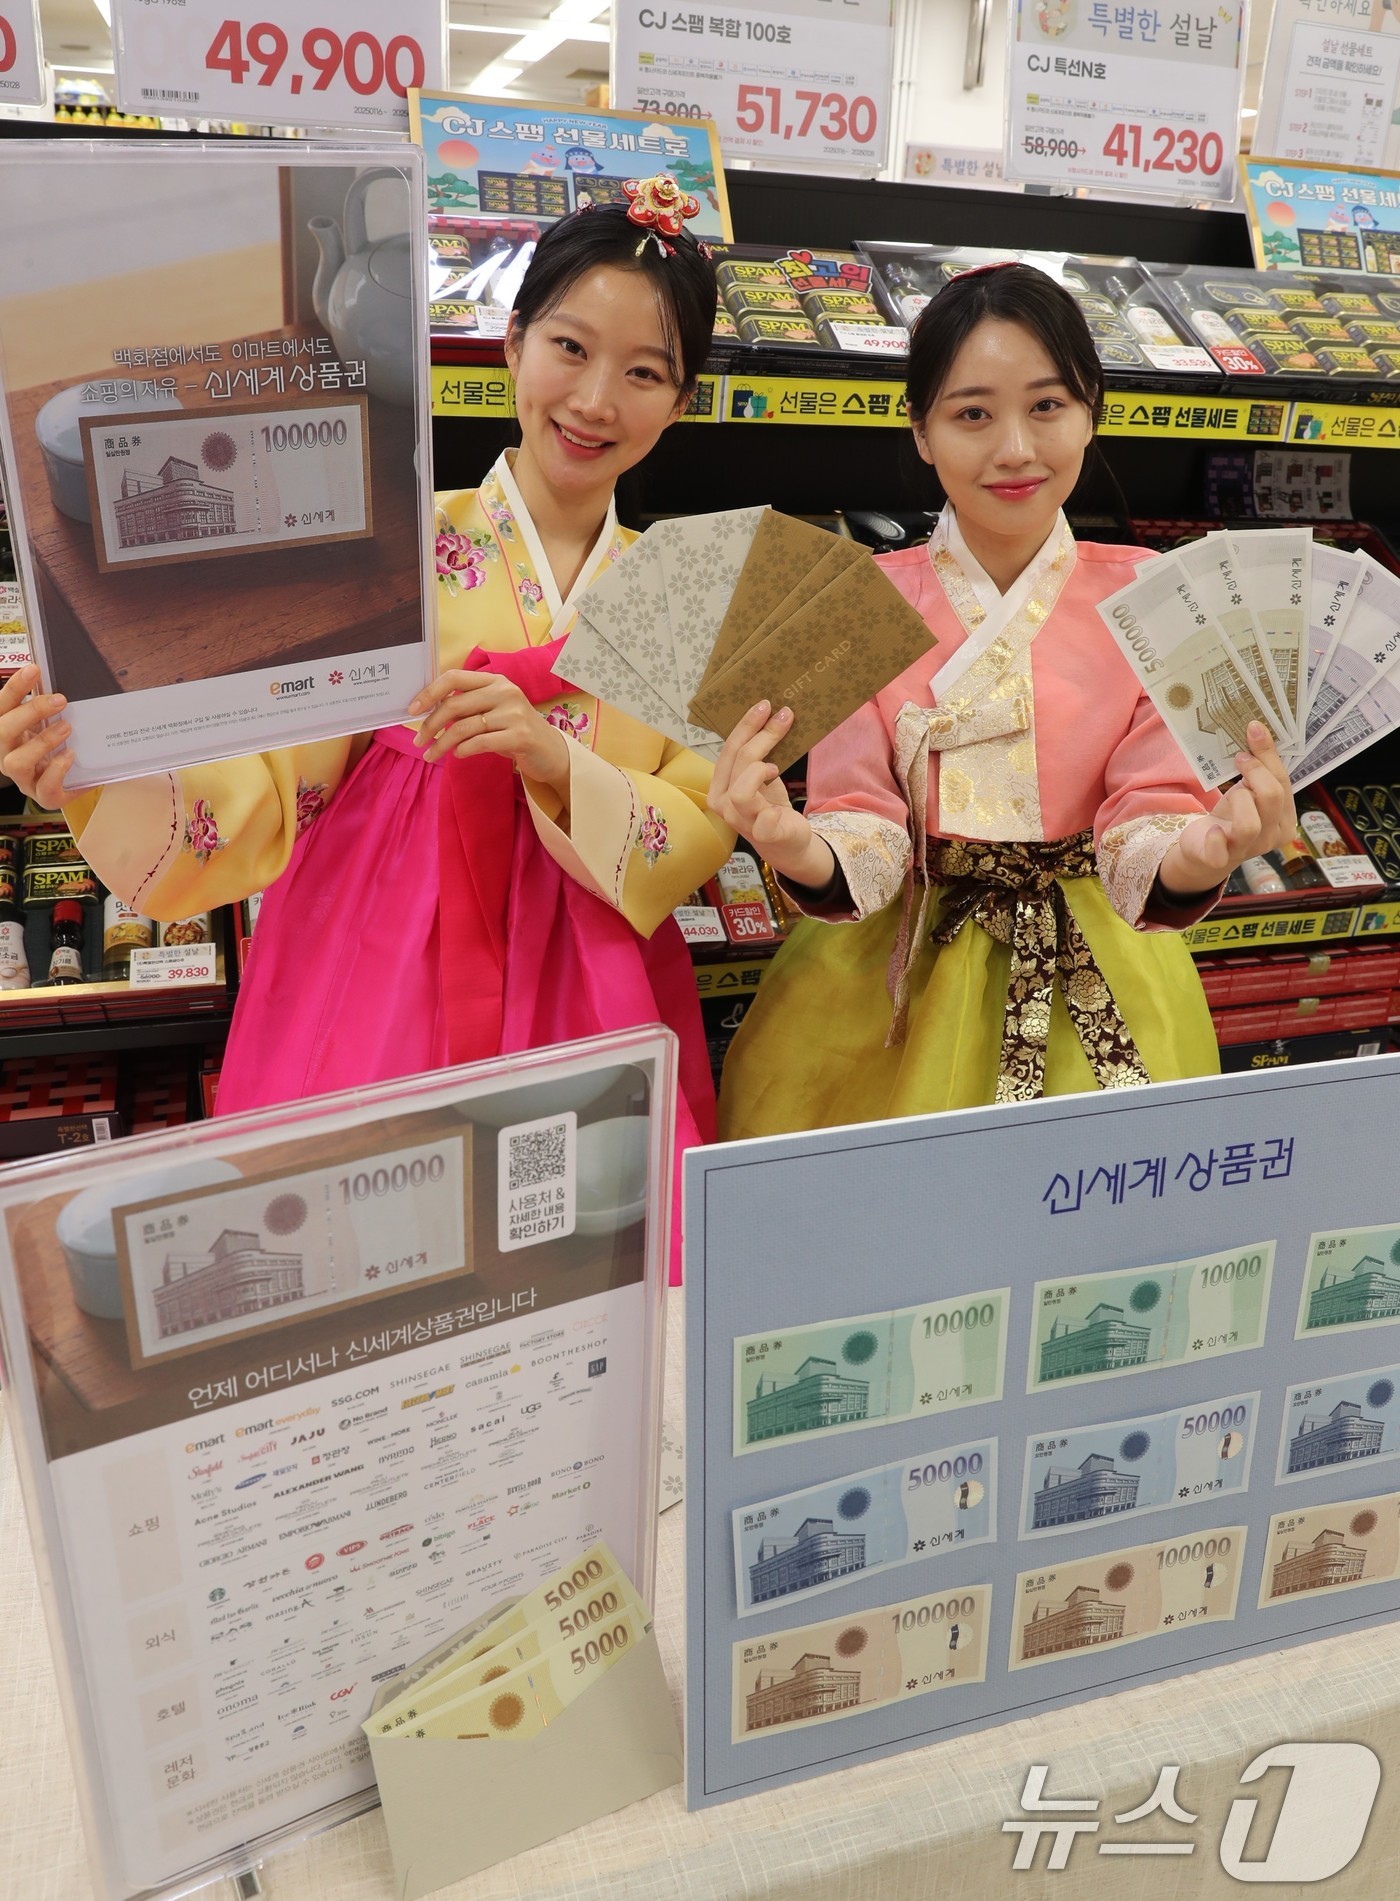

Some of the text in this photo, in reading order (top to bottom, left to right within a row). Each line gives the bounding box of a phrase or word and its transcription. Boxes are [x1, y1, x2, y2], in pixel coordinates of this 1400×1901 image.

[639, 9, 792, 44] CJ 스팸 복합 100호
[1087, 1, 1218, 49] 특별한 설날
[205, 20, 425, 97] 49,900
[1322, 38, 1373, 58] 설날 선물세트
[1027, 54, 1106, 80] CJ 특선N호
[736, 84, 878, 144] 51,730
[442, 115, 690, 159] CJ 스팸 선물세트로
[1025, 136, 1077, 159] 58,900
[1103, 122, 1223, 176] 41,230
[1265, 181, 1400, 209] CJ 스팸 선물세
[735, 265, 781, 277] SPAM
[781, 258, 872, 281] 최고의
[744, 291, 793, 303] SPAM
[822, 295, 869, 307] SPAM
[758, 320, 807, 332] SPAM
[1244, 313, 1281, 324] SPAM
[1307, 323, 1344, 334] SPAM
[113, 338, 332, 368] 백화점에서도 이마트에서도
[1264, 339, 1308, 352] SPAM
[1225, 356, 1259, 371] 30%
[1332, 352, 1370, 363] SPAM
[81, 360, 368, 404] 쇼핑의 자유 신세계 상품권
[440, 380, 506, 406] 선물은
[780, 391, 837, 415] 선물은
[842, 393, 891, 416] 스팸
[1099, 405, 1238, 429] 물은 스팸 선물세트
[1331, 417, 1400, 438] 선물은 스
[104, 434, 142, 450] 商品券
[261, 419, 348, 453] 100000
[301, 510, 336, 526] 신세계
[1218, 559, 1238, 591] 신세계
[1291, 557, 1303, 590] 신세계
[1176, 583, 1200, 612] 신세계
[1329, 579, 1350, 613] 신세계
[1112, 603, 1165, 675] 500000
[349, 663, 390, 681] 신세계
[783, 640, 851, 699] GIFT CARD
[270, 676, 315, 695] emart
[34, 871, 84, 886] SPAM
[684, 926, 719, 937] 44,030
[733, 917, 767, 936] 30%
[1222, 922, 1257, 941] 스팸
[1261, 918, 1317, 937] 선물세트
[168, 966, 209, 980] 39,830
[1251, 1054, 1289, 1068] SPAM
[57, 1131, 90, 1144] T-2호
[339, 1154, 445, 1205] 100000
[1042, 1137, 1295, 1215] 신세계 상품권
[509, 1187, 565, 1213] 사용처 &
[509, 1203, 564, 1226] 자세한 내용
[509, 1215, 564, 1240] 확인하기
[1317, 1238, 1347, 1250] 商品券
[385, 1251, 428, 1275] 신세계
[1200, 1254, 1262, 1289] 10000
[1043, 1286, 1077, 1300] 商品券
[922, 1303, 995, 1340] 10000
[188, 1287, 538, 1409] 언제 어디서나 신세계상품권입니다
[746, 1340, 782, 1356] 商品券
[1206, 1331, 1239, 1348] 신세계
[460, 1341, 511, 1364] SHINSEGAE
[531, 1338, 608, 1367] BOONTHESHOP
[390, 1363, 450, 1390] SHINSEGAE
[465, 1370, 509, 1389] casamia
[331, 1386, 380, 1408] SSG.COM
[936, 1383, 973, 1402] 신세계
[1293, 1388, 1322, 1402] 商品券
[520, 1402, 542, 1415] UGG
[235, 1419, 275, 1438] emart
[470, 1415, 505, 1433] sacai
[1181, 1404, 1247, 1440] 50000
[185, 1434, 225, 1454] emart
[290, 1427, 325, 1446] JAJU
[1035, 1438, 1068, 1453] 商品券
[273, 1474, 332, 1499] ALEXANDER
[333, 1464, 365, 1479] WANG
[907, 1452, 984, 1492] 50000
[552, 1485, 581, 1501] Market
[1192, 1477, 1224, 1495] 신세계
[194, 1501, 257, 1526] Acne Studios
[744, 1507, 780, 1525] 商品券
[1277, 1516, 1306, 1530] 商品券
[127, 1516, 160, 1537] 쇼핑
[929, 1528, 965, 1548] 신세계
[1157, 1536, 1232, 1570] 100000
[544, 1559, 603, 1612] 5000
[1025, 1573, 1057, 1588] 商品券
[558, 1591, 618, 1641] 5000
[892, 1596, 975, 1634] 100000
[1177, 1605, 1208, 1622] 신세계
[145, 1629, 176, 1650] 외식
[570, 1624, 628, 1675] 5000
[743, 1641, 779, 1658] 商品券
[921, 1668, 956, 1686] 신세계
[330, 1685, 356, 1701] CGV
[156, 1700, 186, 1722] 호텔
[164, 1753, 194, 1775] 레저
[166, 1769, 196, 1790] 문화
